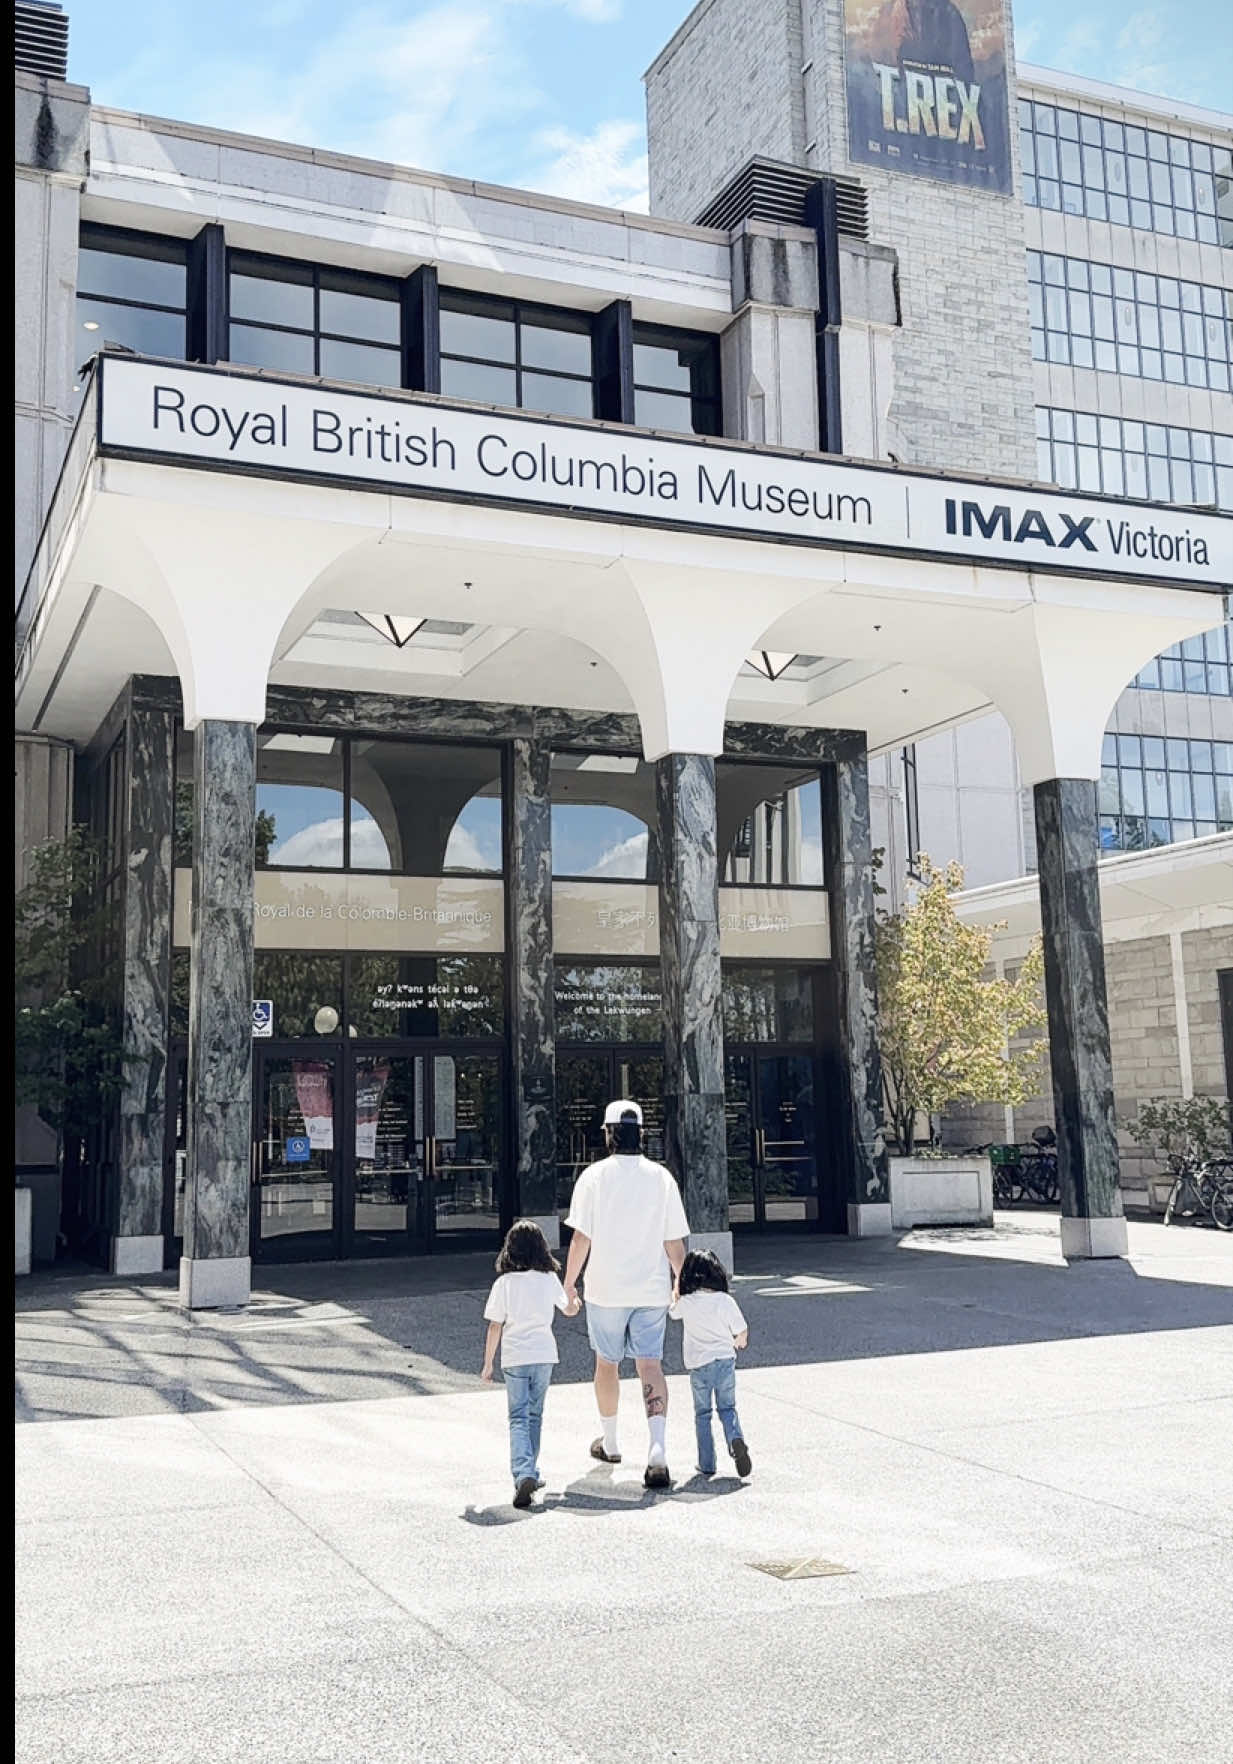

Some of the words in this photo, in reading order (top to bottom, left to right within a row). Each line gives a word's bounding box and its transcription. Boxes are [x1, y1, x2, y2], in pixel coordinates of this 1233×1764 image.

[872, 62, 986, 150] T.REX
[152, 385, 287, 451] Royal
[313, 409, 456, 471] British
[477, 434, 679, 500] Columbia
[698, 465, 873, 525] Museum
[945, 498, 1099, 552] IMAX
[1107, 519, 1210, 566] Victoria
[296, 904, 313, 917] de
[320, 905, 332, 919] la
[554, 991, 594, 1001] Welcome
[597, 992, 606, 1001] to
[608, 991, 621, 1001] the
[574, 1006, 582, 1015] of
[586, 1006, 600, 1015] the
[604, 1006, 652, 1017] Lekwungen
